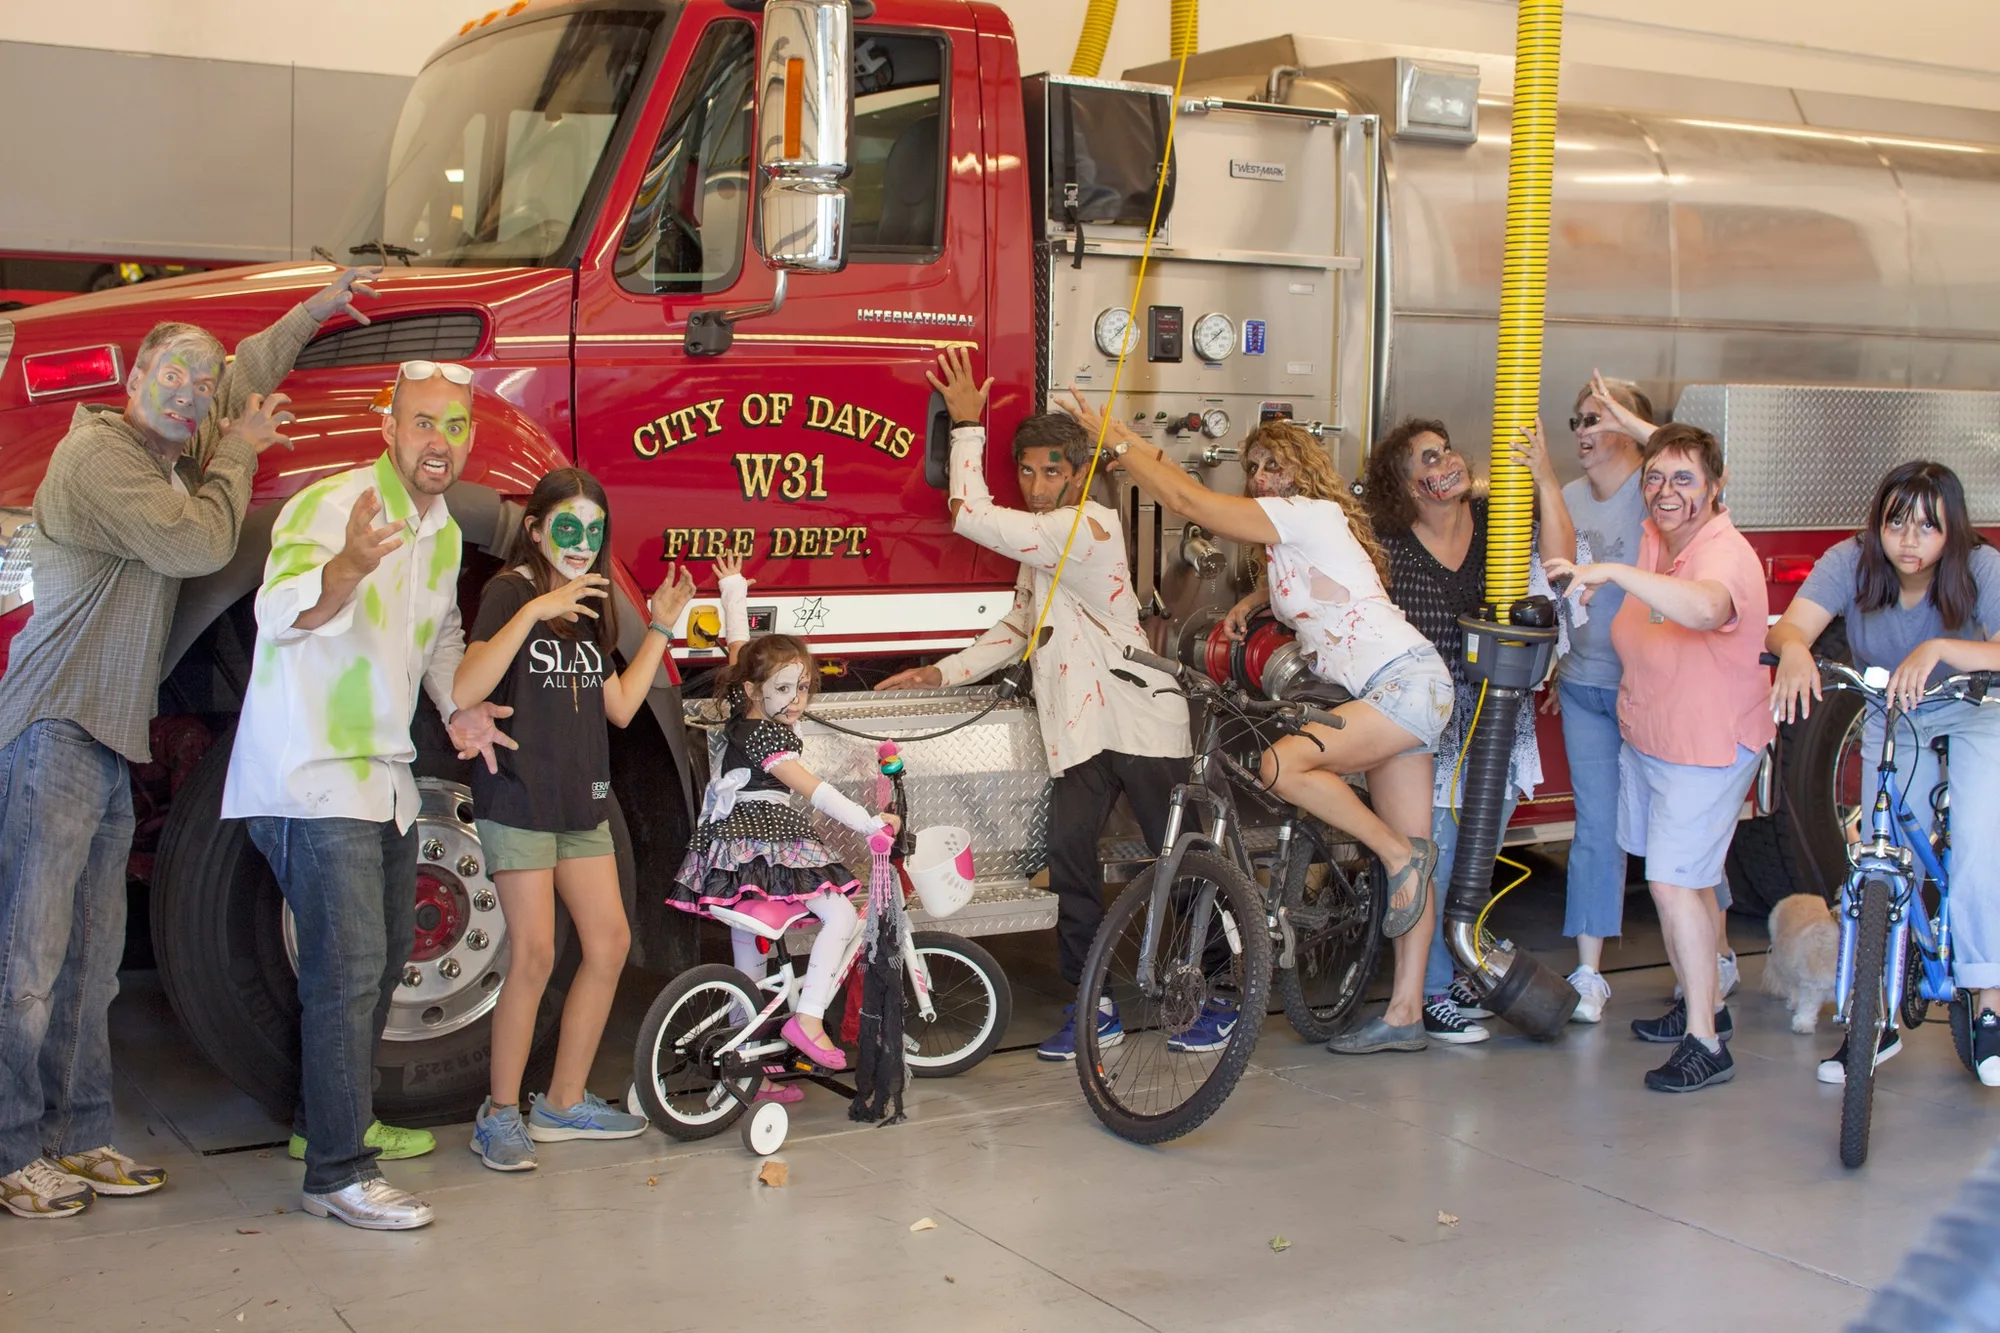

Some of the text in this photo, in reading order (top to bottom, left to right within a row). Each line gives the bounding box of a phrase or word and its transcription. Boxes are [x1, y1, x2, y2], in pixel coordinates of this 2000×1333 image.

[857, 308, 976, 328] INTERNATIONAL
[632, 393, 916, 460] CITY OF DAVIS
[733, 452, 828, 501] W31
[662, 526, 872, 561] FIRE DEPT.
[800, 608, 821, 621] 224
[529, 638, 603, 674] SLAY
[542, 674, 605, 689] ALL DAY
